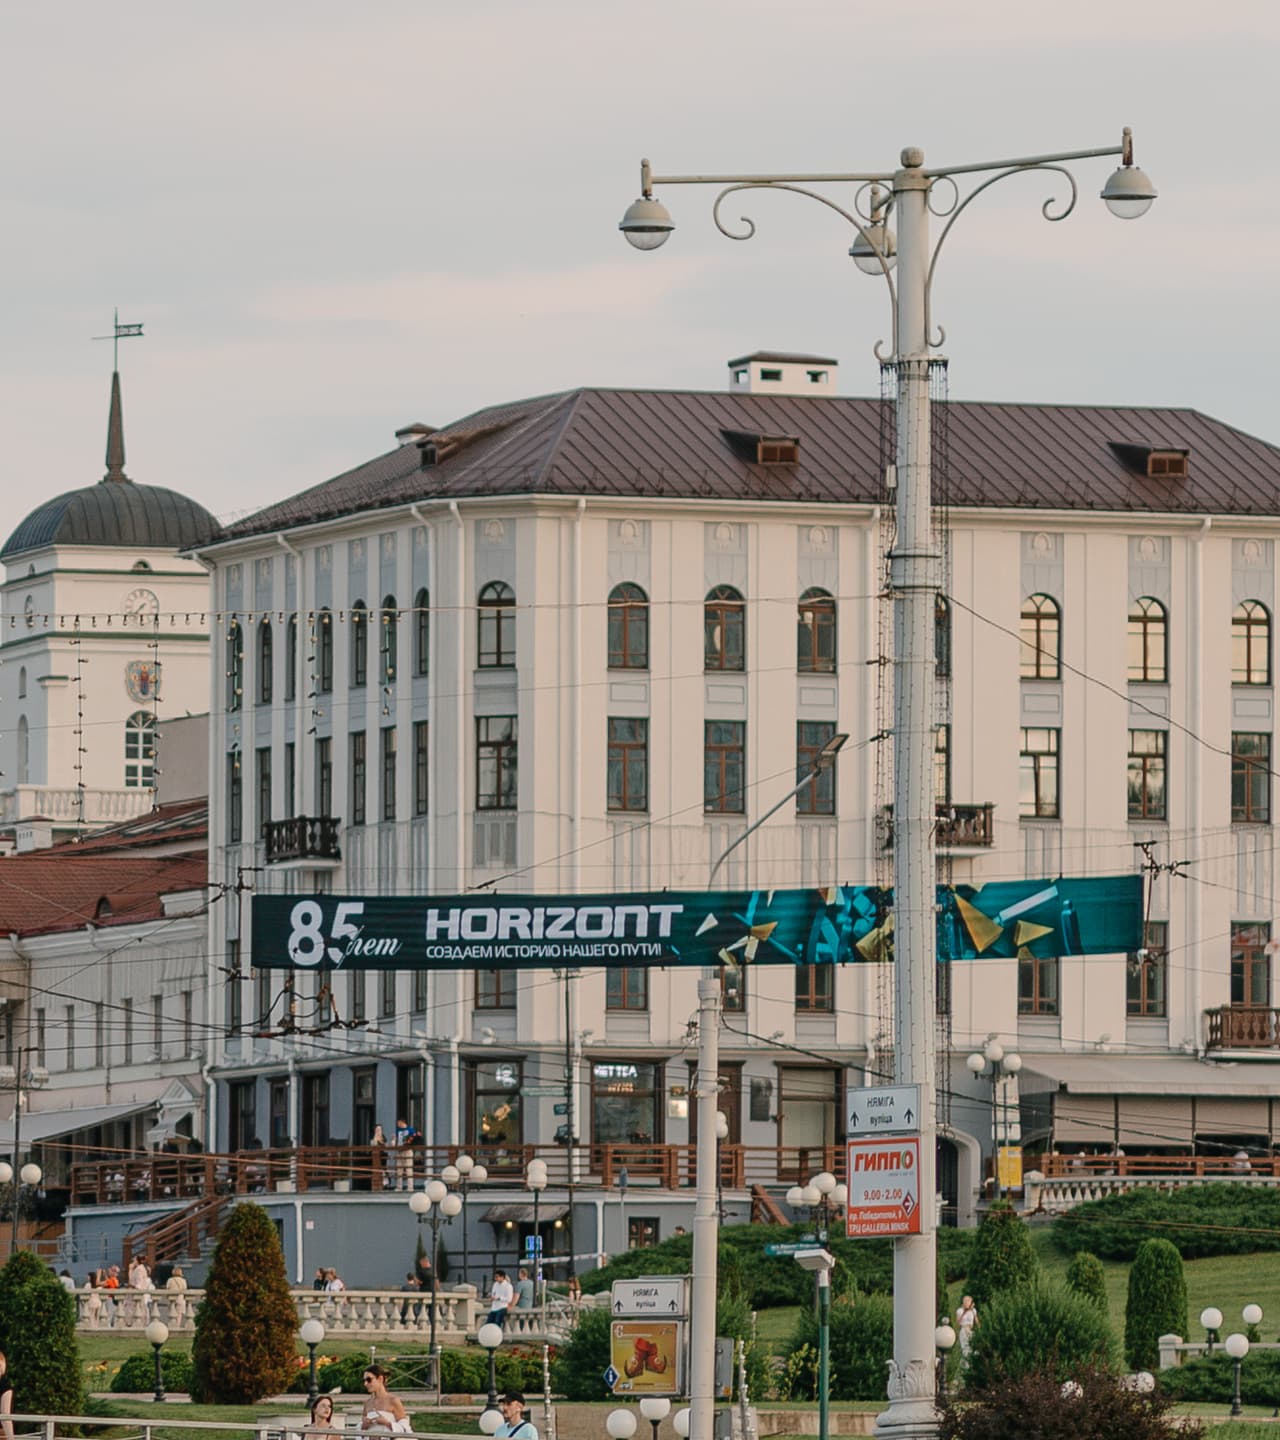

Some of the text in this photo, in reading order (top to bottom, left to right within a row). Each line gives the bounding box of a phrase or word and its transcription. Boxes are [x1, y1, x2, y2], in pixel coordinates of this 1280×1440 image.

[288, 900, 403, 966] 85 лет
[426, 943, 662, 960] СОЗДАЕМ ИСТОРИЮ НАШЕГО ПУТИ!
[866, 1096, 895, 1108] НЯМІГА
[854, 1150, 914, 1172] ГИППО
